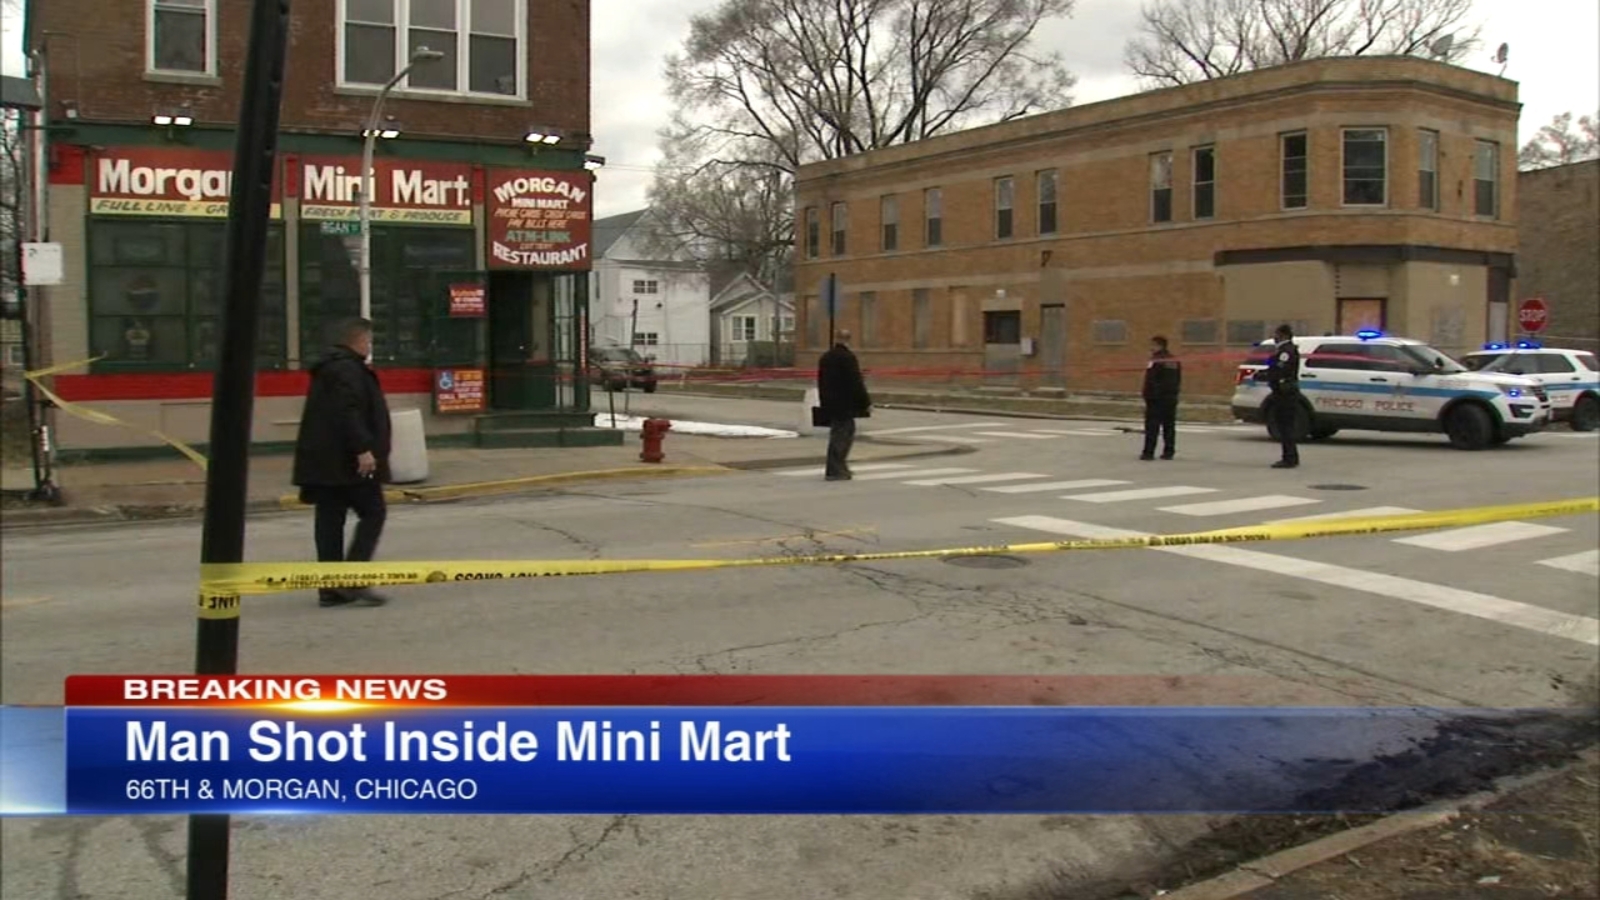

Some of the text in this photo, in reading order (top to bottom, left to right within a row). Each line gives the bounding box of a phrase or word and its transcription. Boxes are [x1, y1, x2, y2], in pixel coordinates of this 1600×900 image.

[99, 158, 471, 206] Morga Mini Mart.
[493, 177, 586, 203] MORGAN
[96, 200, 142, 211] FULL
[145, 202, 188, 213] LINE
[511, 198, 568, 209] MINI MART
[400, 210, 463, 221] PRODUCE
[493, 241, 588, 265] RESTAURANT
[1519, 309, 1546, 322] STOP
[1317, 397, 1415, 411] CHICAGO POLICE
